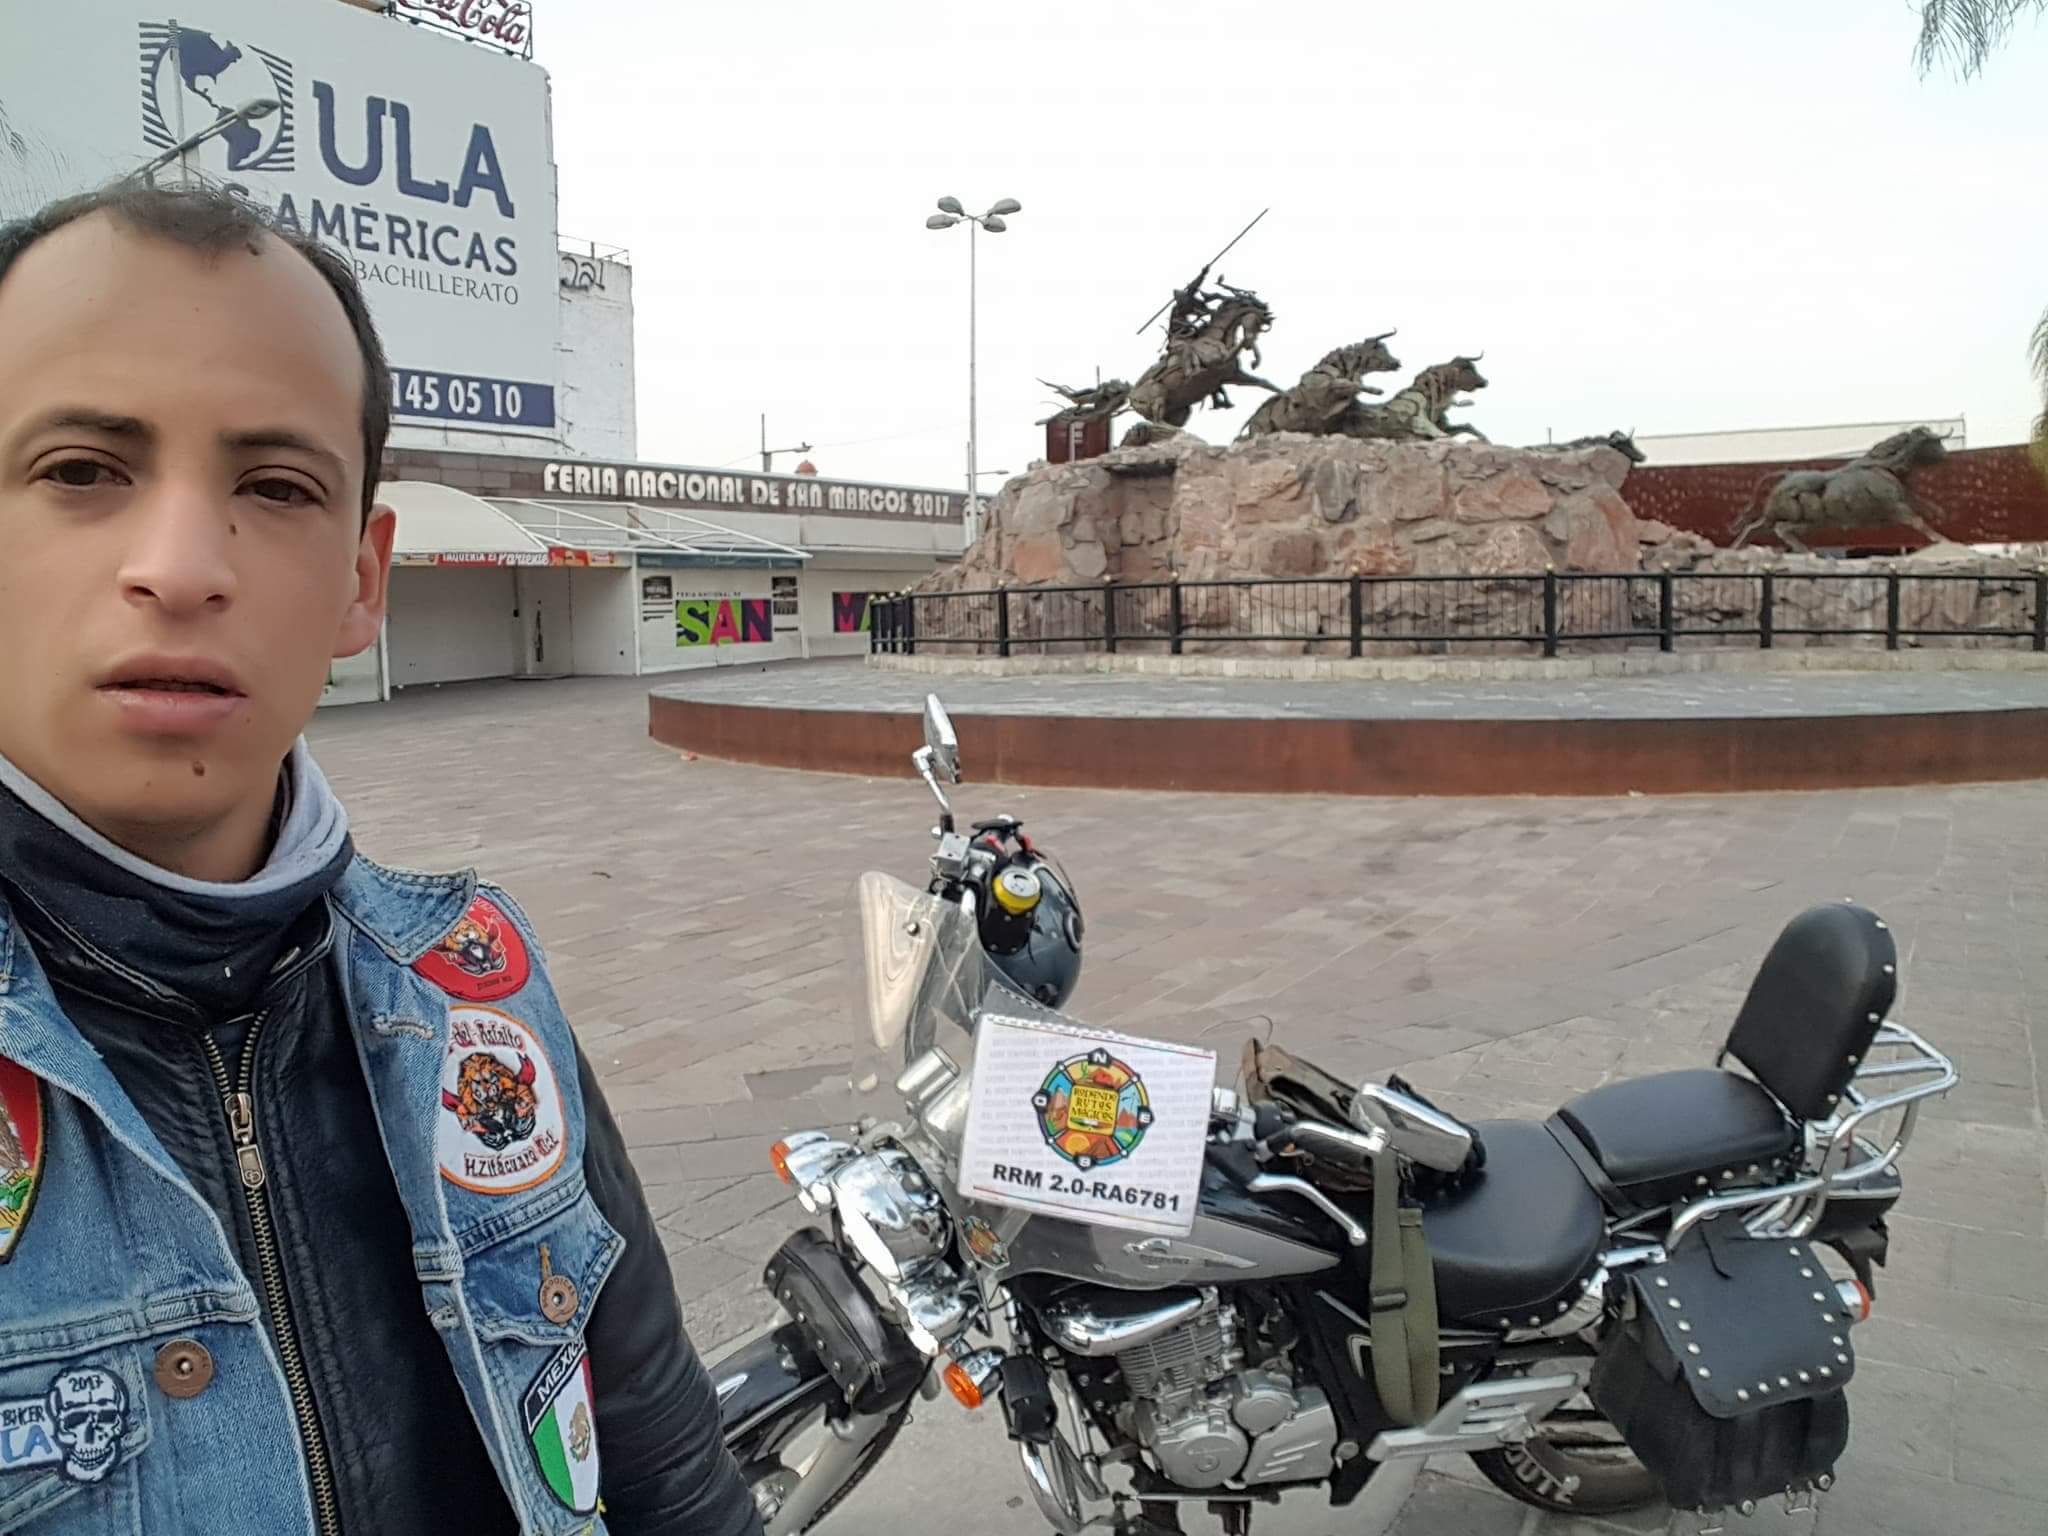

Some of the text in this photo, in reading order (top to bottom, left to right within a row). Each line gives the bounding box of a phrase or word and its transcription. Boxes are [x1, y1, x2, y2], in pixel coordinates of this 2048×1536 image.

[312, 80, 515, 219] ULA
[273, 193, 518, 276] AMÉRICAS
[354, 259, 518, 305] BACHILLERATO
[391, 372, 522, 419] 145 05 10
[543, 463, 950, 516] FERIA NACIONAL DE SAN MARCOS 2017
[677, 598, 772, 646] SAN
[992, 1163, 1180, 1213] RRM 2.0-RA6781
[68, 1374, 104, 1393] 2017
